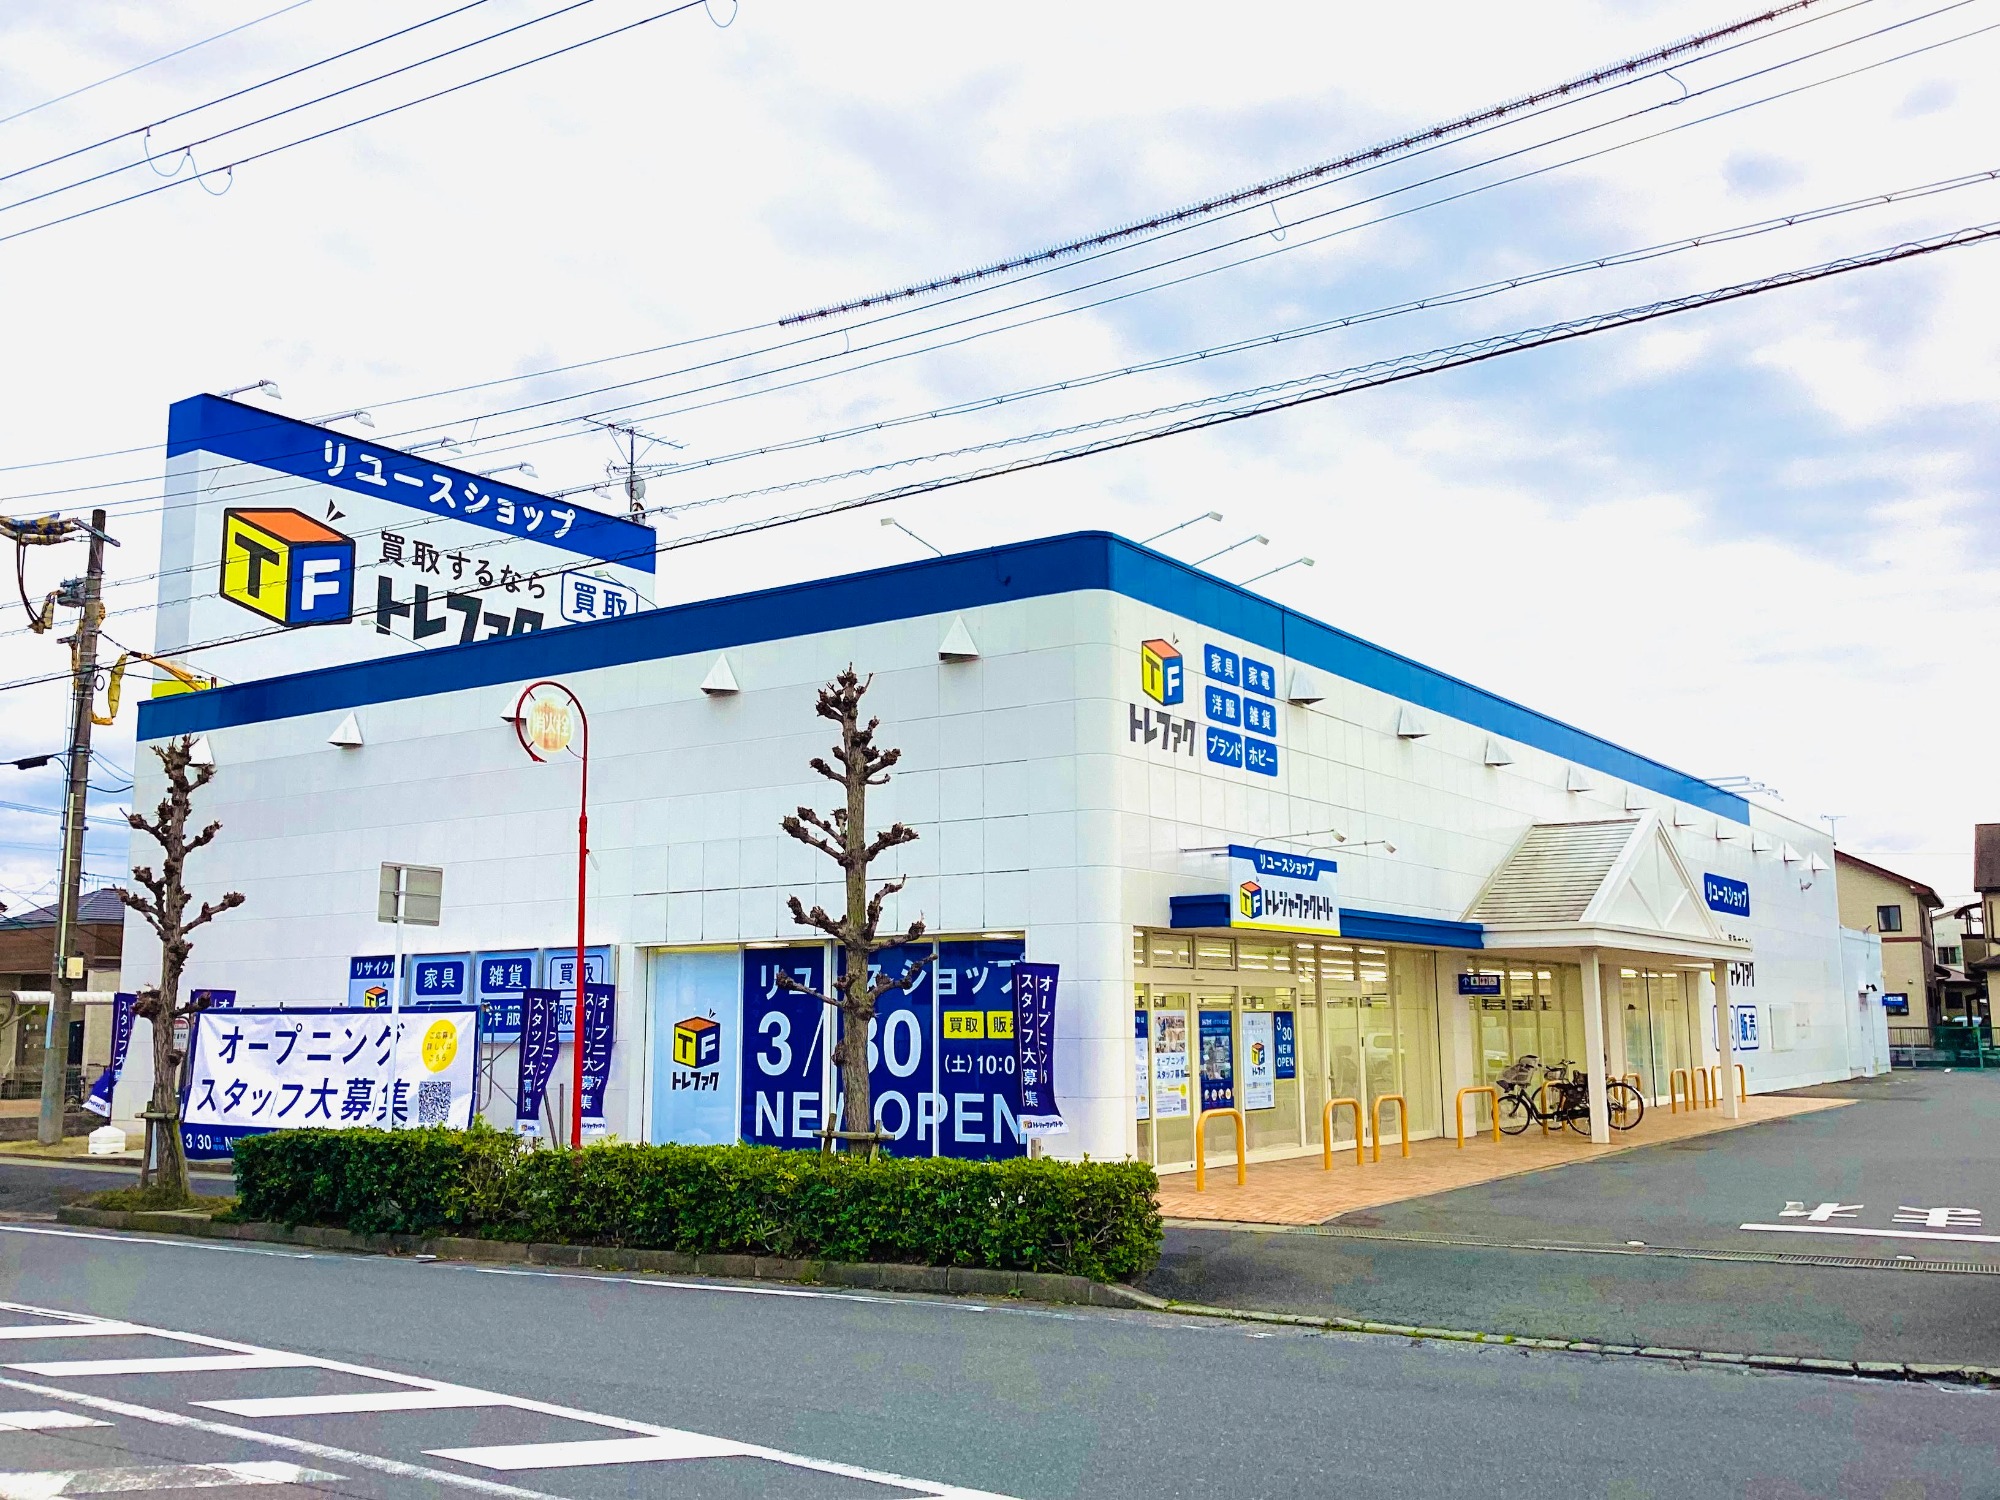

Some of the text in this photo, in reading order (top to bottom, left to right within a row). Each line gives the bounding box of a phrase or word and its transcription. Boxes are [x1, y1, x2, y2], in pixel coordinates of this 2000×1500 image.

[323, 440, 577, 539] リユースショップ
[378, 530, 546, 600] 買取するなら
[572, 582, 629, 619] 買取
[1210, 653, 1270, 691] 家具 家電
[1212, 693, 1271, 731] 洋服 雑貨
[1129, 702, 1196, 757] トレファク
[1208, 735, 1275, 768] ブランド ホビー
[1259, 853, 1315, 876] リユースショップ
[1265, 889, 1333, 921] トレジャーファクトリー
[1707, 881, 1748, 908] リユースショップ
[423, 967, 456, 989] 家具
[489, 964, 523, 987] 雑貨
[487, 1005, 521, 1027] 洋服
[557, 1004, 573, 1026] 販
[949, 1016, 979, 1033] 買取
[1739, 1013, 1757, 1042] 販売
[218, 1022, 405, 1067] オープニング
[1020, 974, 1039, 1108] スタッフ大募集
[1277, 1044, 1292, 1054] NEW
[1276, 1057, 1294, 1068] OPEN
[672, 1070, 720, 1092] トレファク
[196, 1077, 410, 1123] スタッフ大募集
[755, 1090, 1028, 1145] NE OPEN
[185, 1133, 212, 1150] 3/30
